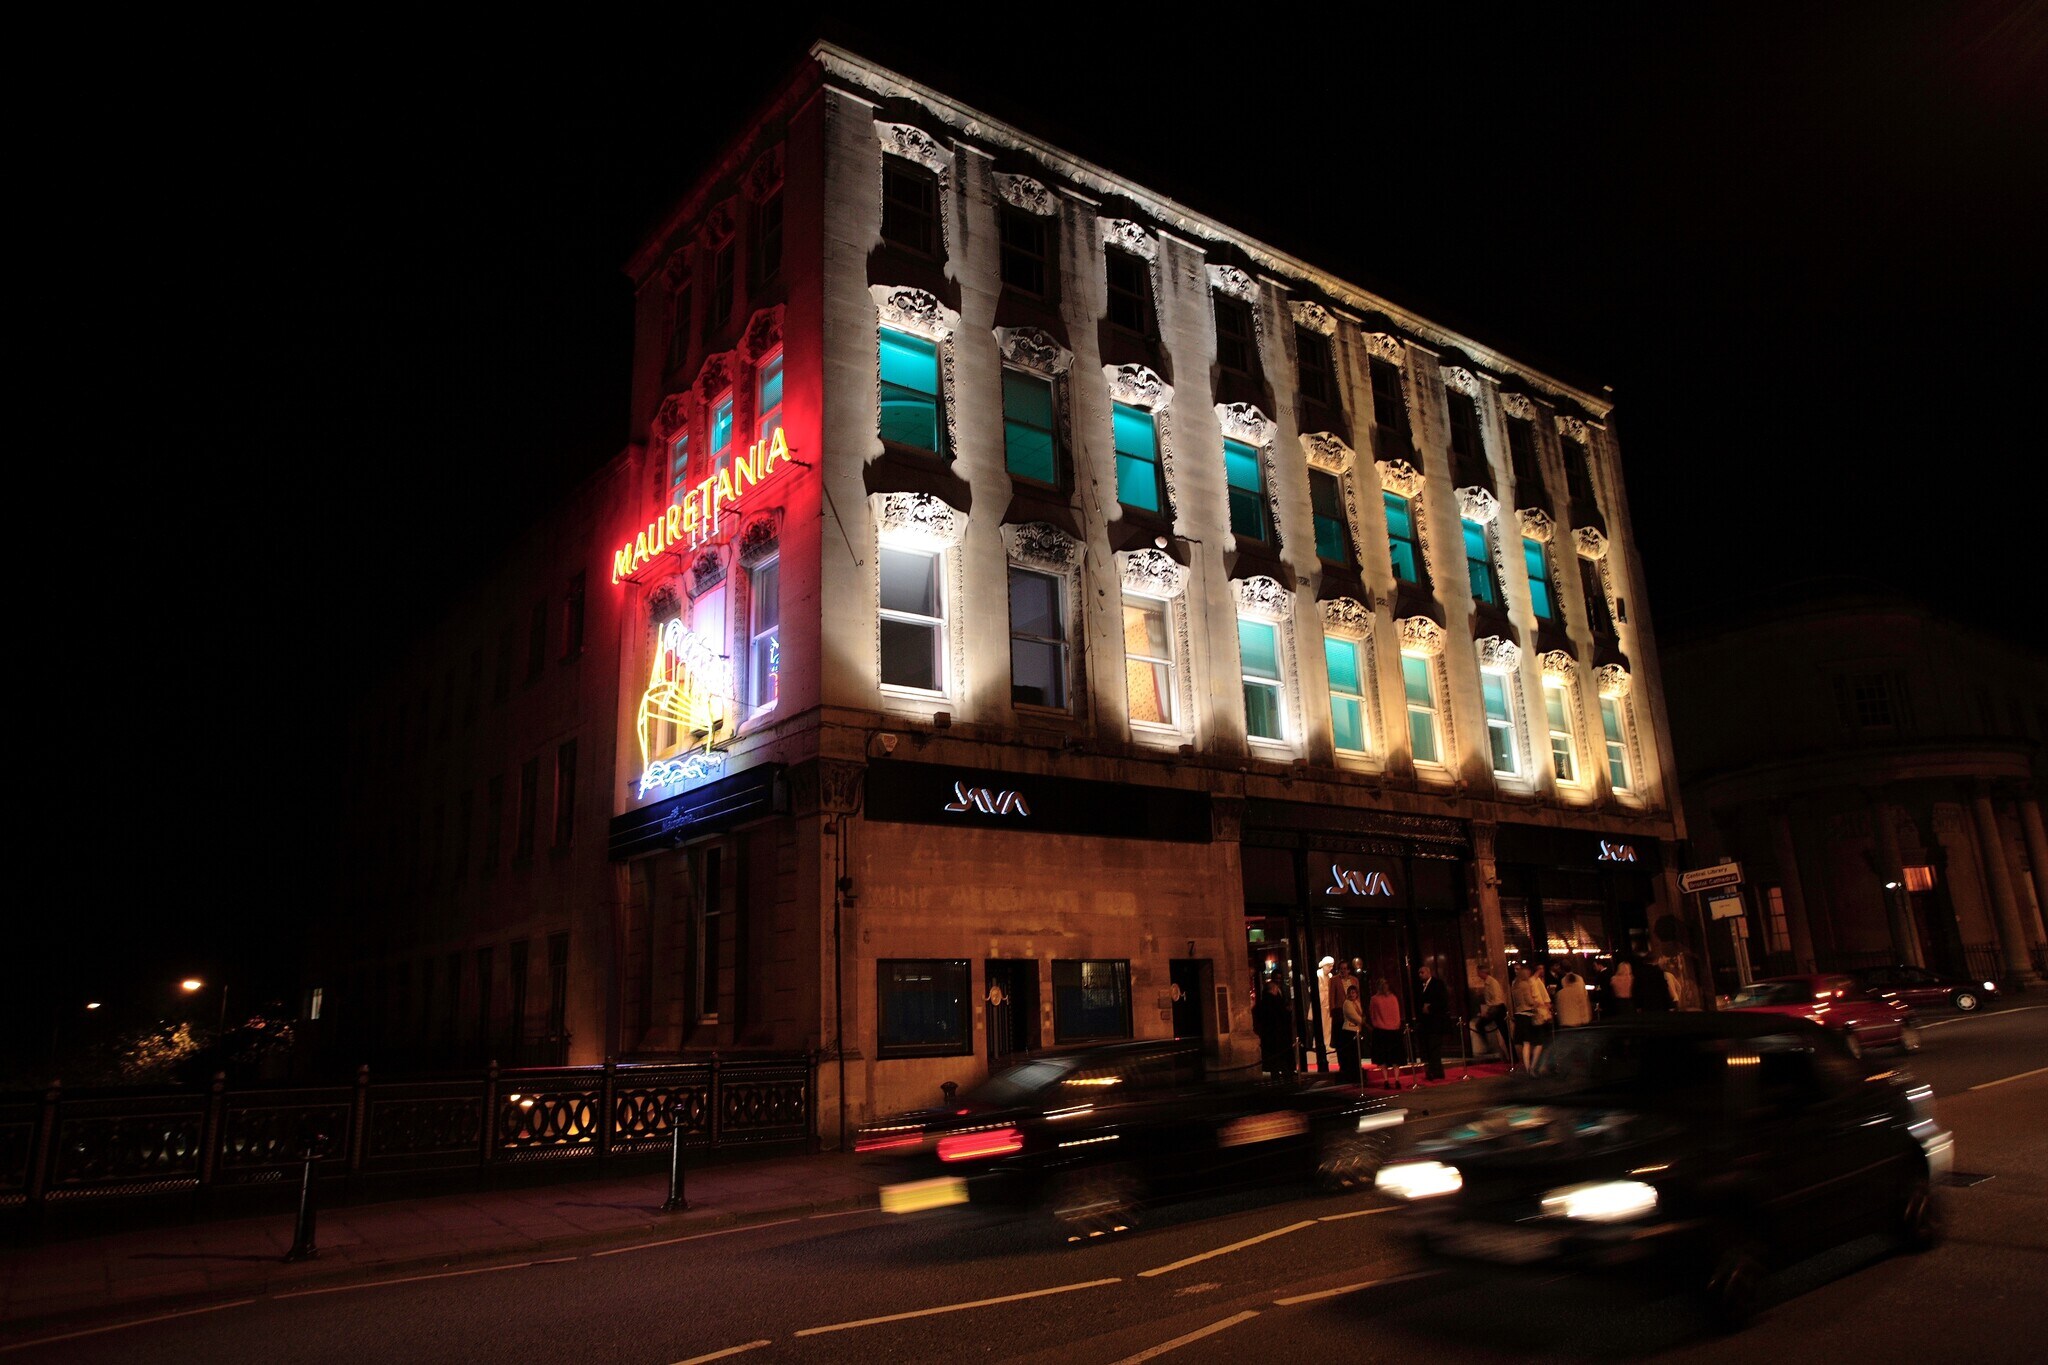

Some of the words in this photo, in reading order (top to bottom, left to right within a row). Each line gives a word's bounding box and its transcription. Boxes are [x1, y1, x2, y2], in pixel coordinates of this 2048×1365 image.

[611, 427, 792, 585] MAURETANIA
[1685, 871, 1706, 880] Central
[1707, 867, 1728, 875] Library
[1689, 880, 1707, 889] Bristol
[1708, 874, 1737, 885] Cathedral
[1187, 941, 1195, 957] 7
